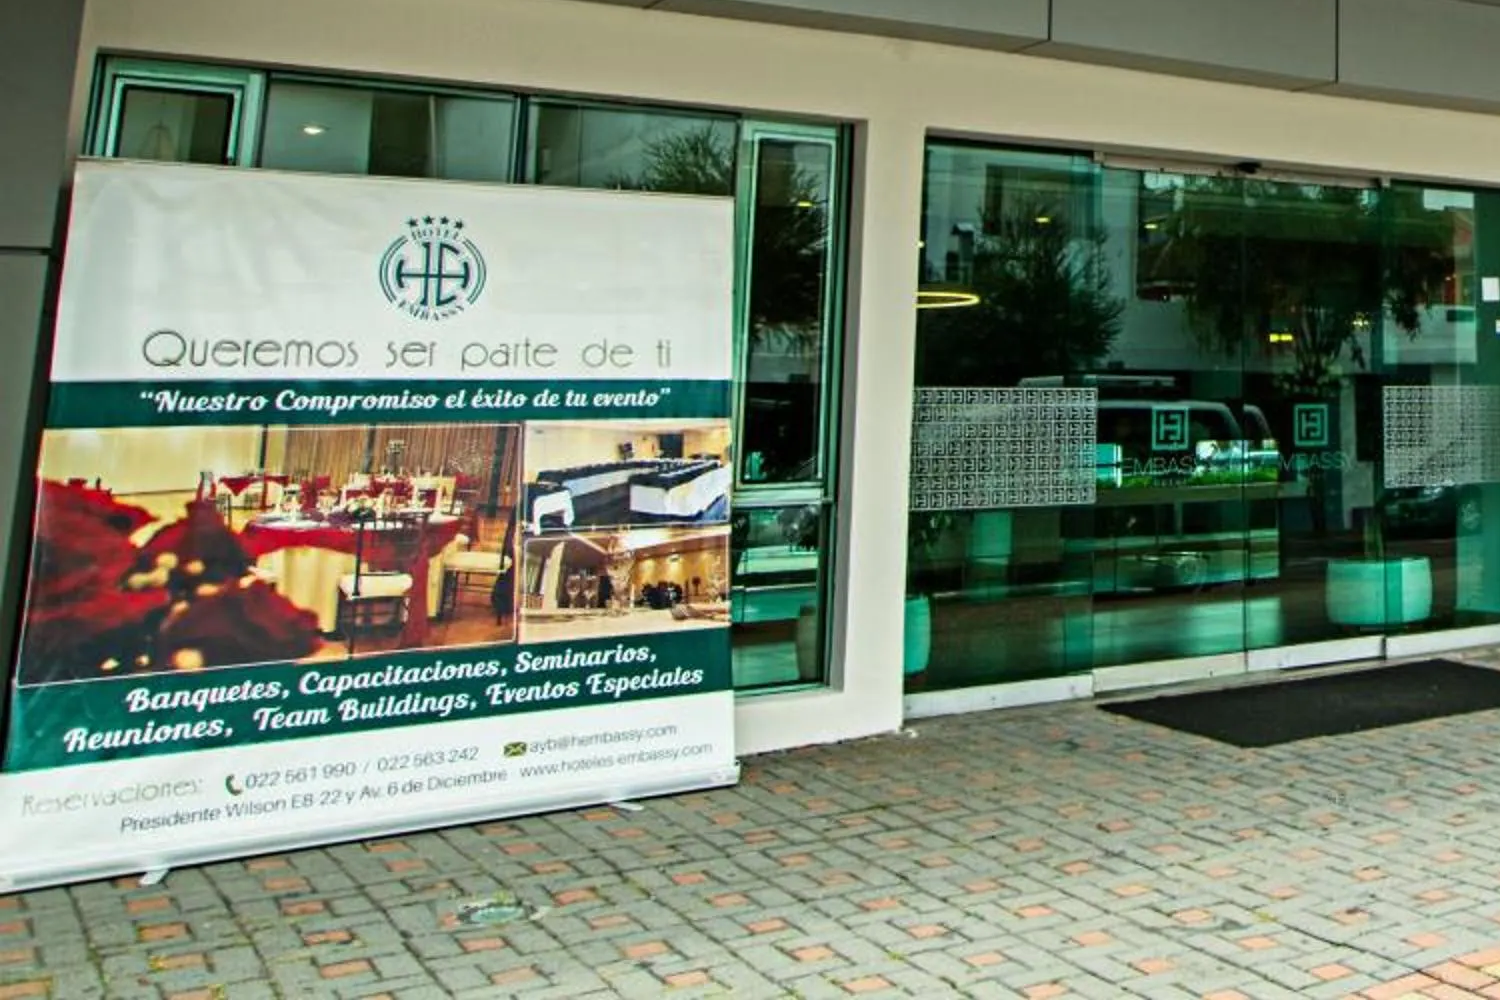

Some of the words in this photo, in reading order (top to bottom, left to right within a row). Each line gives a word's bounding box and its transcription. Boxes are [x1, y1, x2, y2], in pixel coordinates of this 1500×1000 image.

[142, 329, 359, 368] Queremos
[385, 341, 437, 369] ser
[460, 338, 558, 371] parte
[581, 338, 635, 369] de
[656, 339, 672, 368] ti
[275, 389, 438, 417] Compromiso
[445, 388, 467, 408] el
[471, 389, 526, 408] éxito
[532, 389, 561, 408] de
[565, 389, 588, 408] tu
[125, 679, 291, 714] Banquetes,
[300, 661, 508, 698] Capacitaciones,
[514, 643, 657, 674] Seminarios,
[63, 720, 235, 753] Reuniones,
[253, 704, 331, 732] Team
[338, 690, 478, 721] Buildings,
[485, 678, 580, 706] Eventos
[586, 665, 705, 699] Especiales
[245, 772, 281, 789] 022
[286, 766, 318, 785] 561
[323, 761, 356, 780] 990
[377, 754, 410, 773] 022
[449, 746, 480, 763] 242
[519, 742, 713, 778] www.hotelesembassy.com
[120, 806, 221, 833] Presidente
[225, 798, 286, 818] Wilson
[387, 781, 398, 795] 6
[401, 779, 424, 794] de
[427, 769, 508, 791] Diciembre
